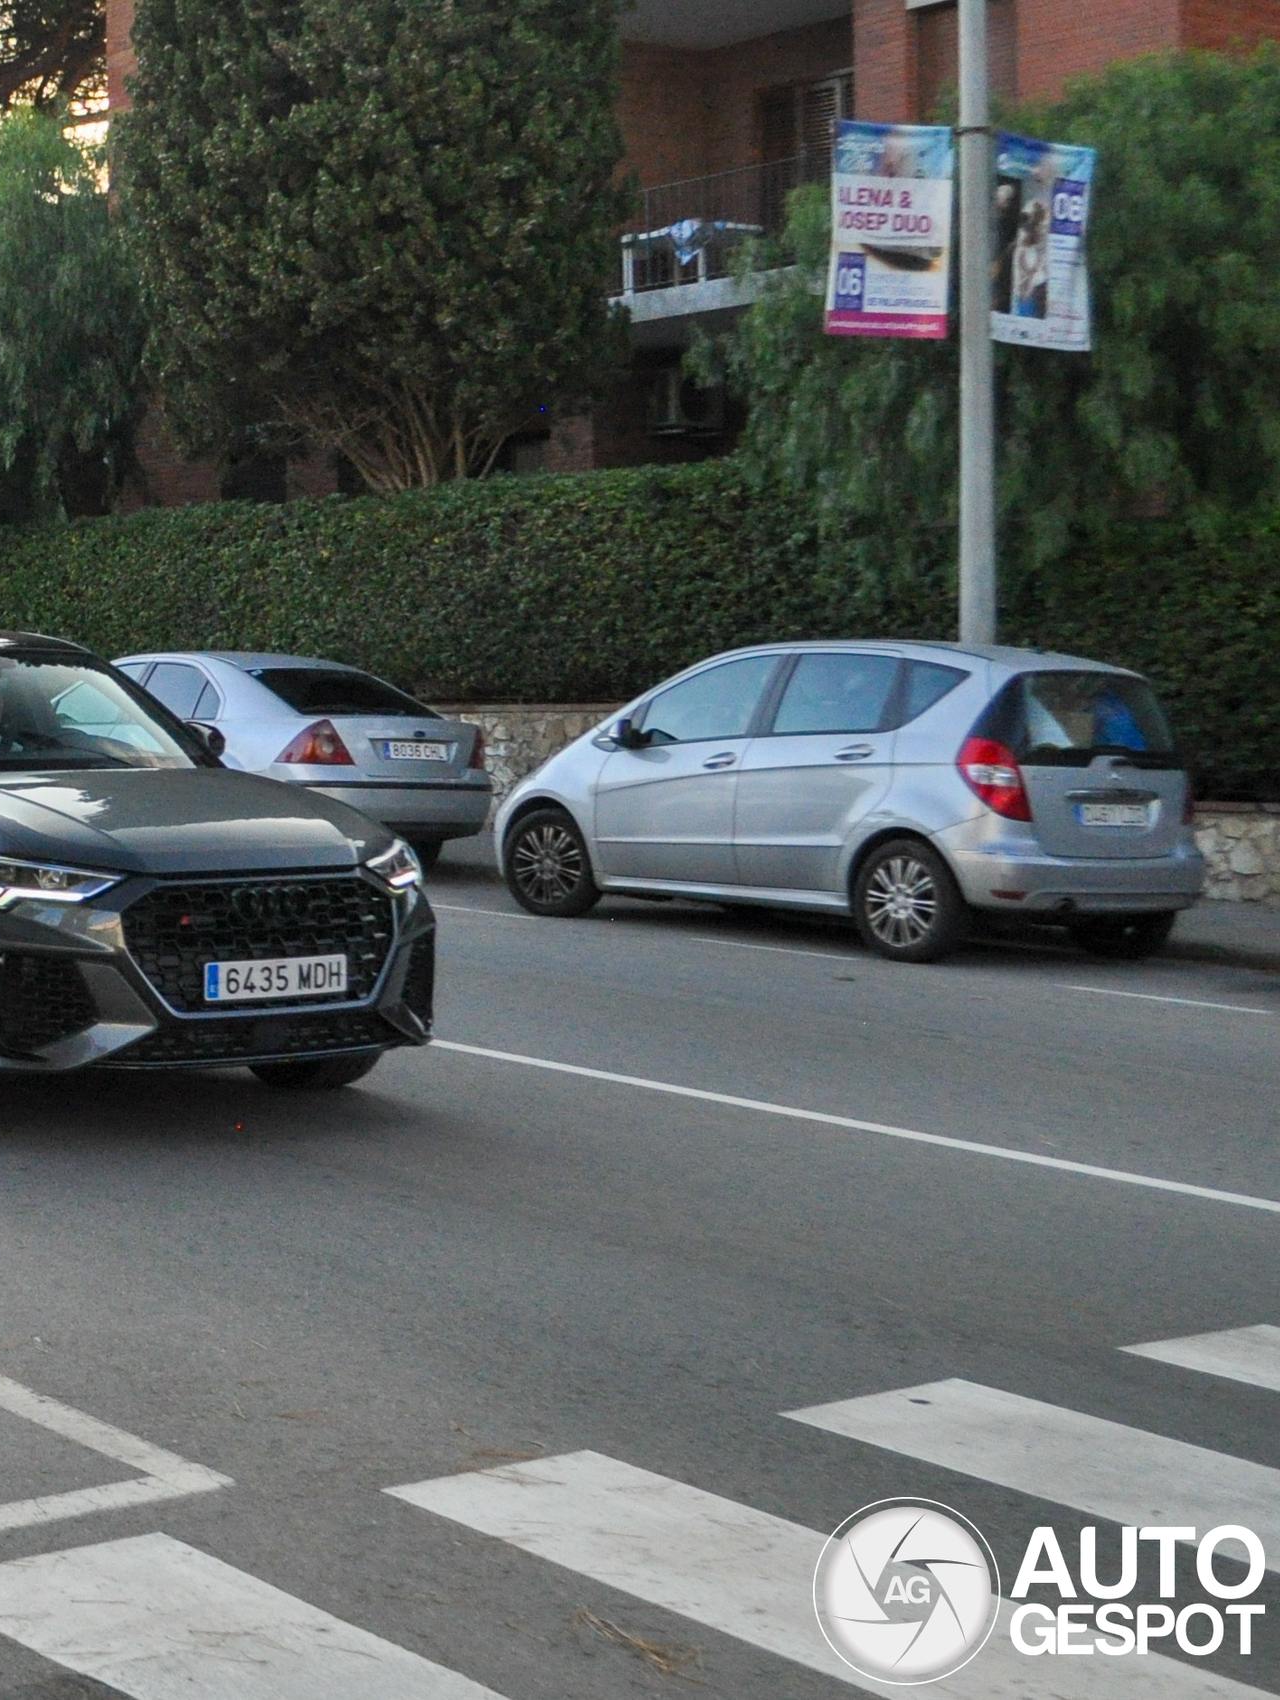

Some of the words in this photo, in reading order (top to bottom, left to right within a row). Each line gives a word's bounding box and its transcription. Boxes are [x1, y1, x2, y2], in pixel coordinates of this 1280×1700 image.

[899, 190, 913, 208] &
[1054, 192, 1084, 222] 06
[893, 214, 932, 234] DUO
[837, 267, 863, 296] 06
[226, 965, 289, 994] 6435
[298, 961, 341, 990] MDH
